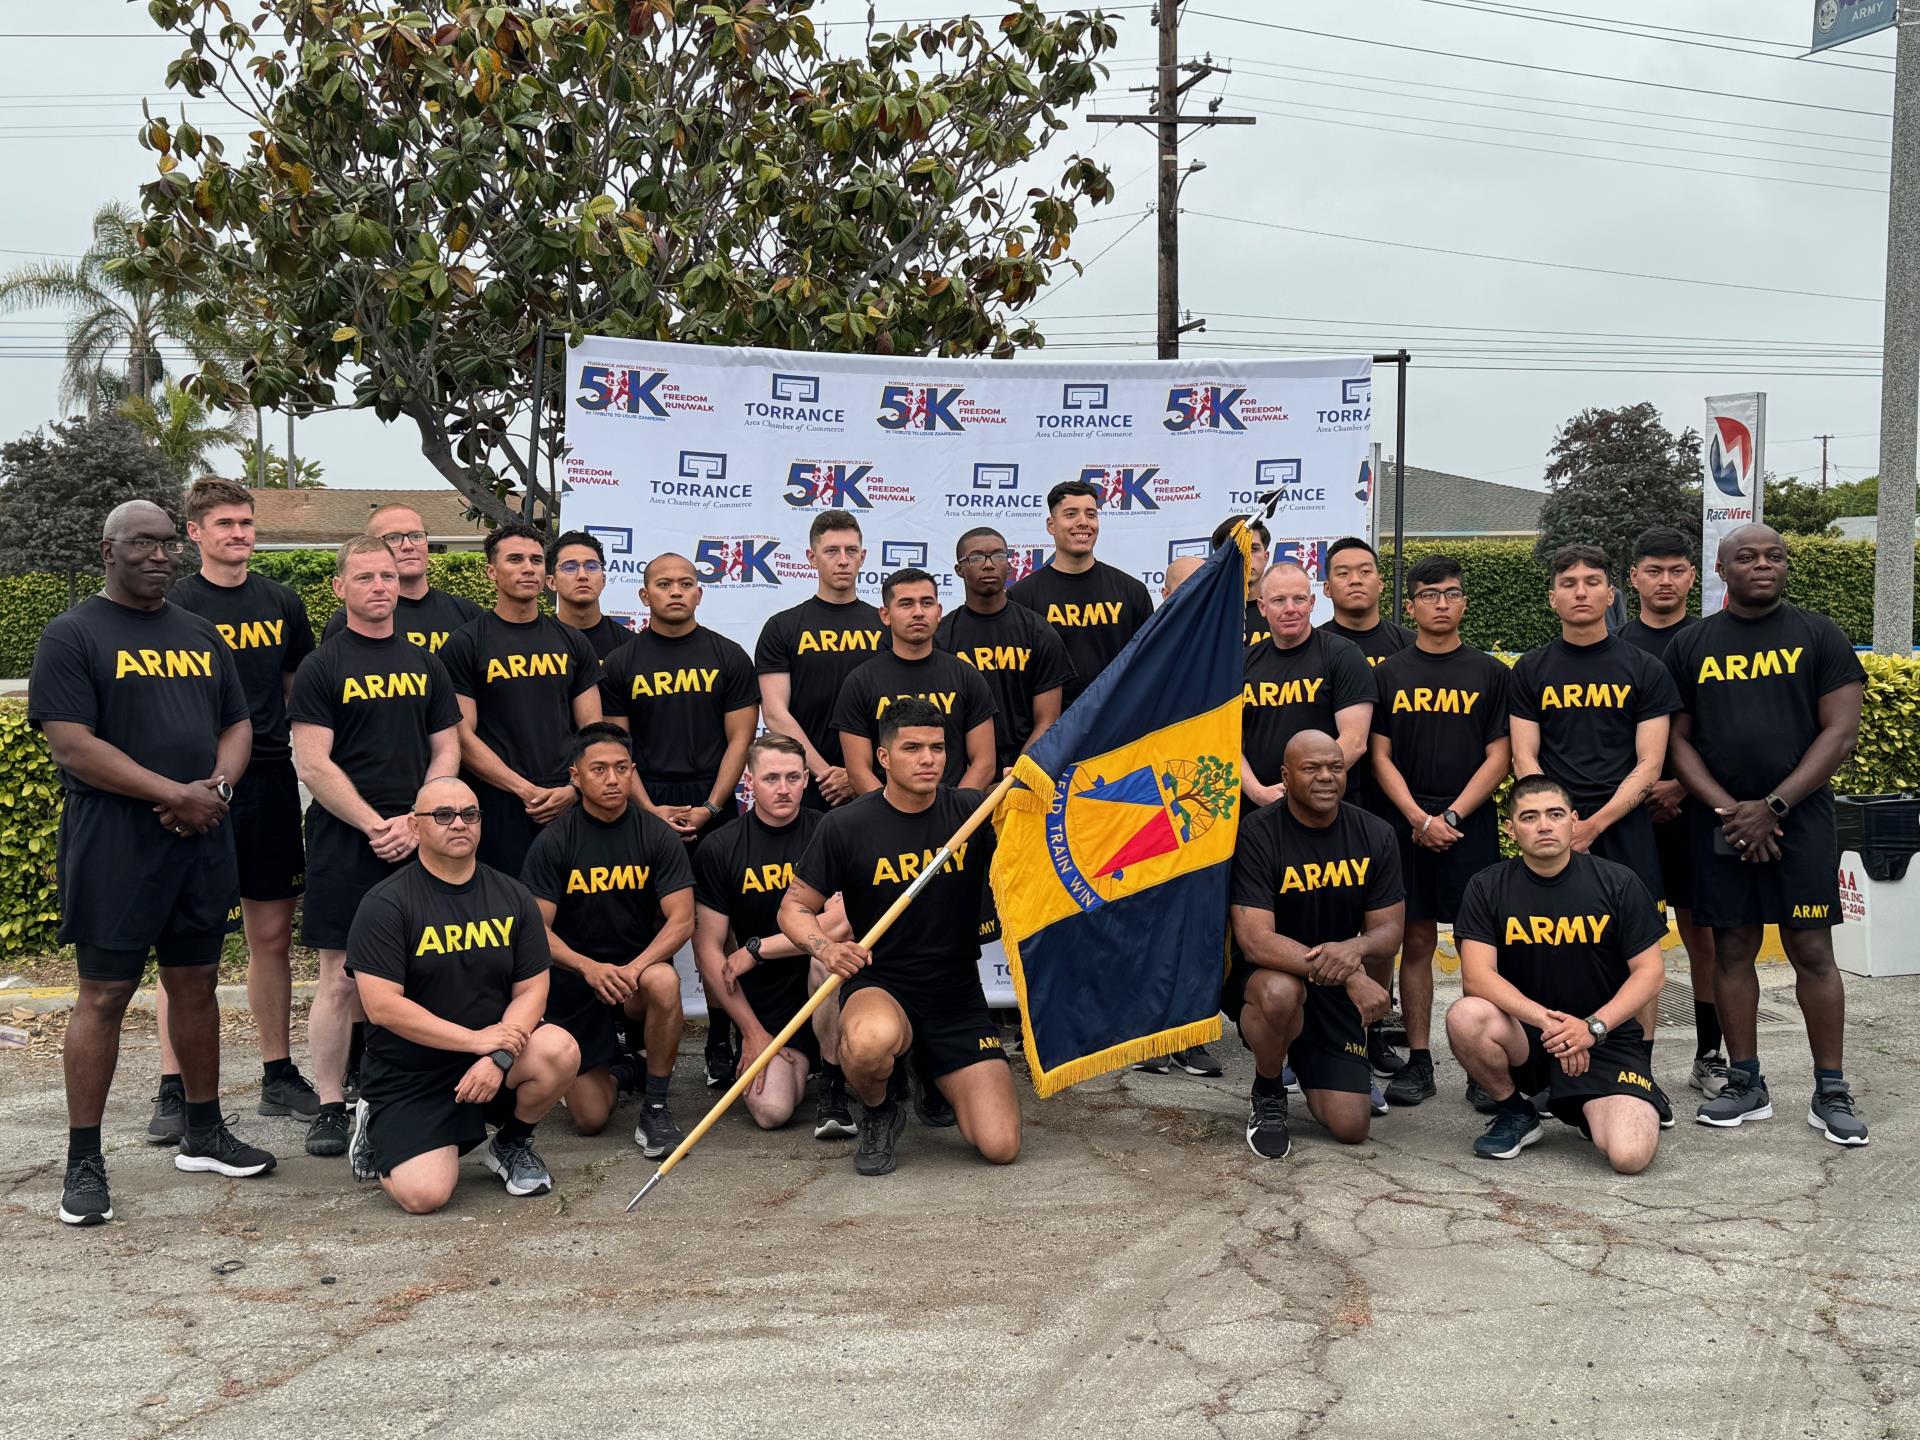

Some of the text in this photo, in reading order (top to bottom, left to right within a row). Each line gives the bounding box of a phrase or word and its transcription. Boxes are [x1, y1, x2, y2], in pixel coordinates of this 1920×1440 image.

[1851, 1, 1883, 22] ARMY
[664, 393, 707, 402] FREEDOM
[665, 402, 715, 412] RUN/WALK
[744, 403, 845, 422] TORRANCE
[1241, 406, 1282, 414] FREEDOM
[960, 416, 1007, 424] RUN/WALK
[1036, 415, 1133, 428] TORRANCE
[1243, 414, 1289, 422] RUN/WALK
[762, 420, 793, 430] Chamber
[796, 424, 805, 432] of
[806, 425, 845, 433] Commerce
[1052, 430, 1084, 438] Chamber
[1086, 430, 1094, 439] of
[1096, 430, 1133, 438] Commerce
[1316, 425, 1332, 433] Area
[1333, 424, 1363, 432] Chamber
[568, 468, 612, 476] FREEDOM
[569, 476, 620, 486] RUN/WALK
[650, 480, 752, 498] TORRANCE
[1154, 485, 1195, 493] FREEDOM
[667, 497, 700, 507] Chamber
[702, 500, 711, 509] of
[713, 501, 752, 509] Commerce
[869, 494, 916, 502] RUN/WALK
[945, 494, 1043, 508] TORRANCE
[1156, 493, 1201, 502] RUN/WALK
[1229, 488, 1325, 504] TORANCE
[995, 510, 1003, 519] of
[1005, 510, 1042, 518] Commerce
[1279, 505, 1287, 513] of
[1706, 507, 1751, 522] RaceWire
[609, 576, 618, 584] of
[777, 570, 819, 579] RUN/WAL
[1047, 602, 1123, 627] ARMY
[216, 619, 284, 649] RMY
[798, 629, 882, 655] ARMY
[116, 649, 212, 679] ARMY
[487, 653, 569, 684] ARMY
[1697, 648, 1803, 684] ARMY
[342, 673, 427, 704] ARMY
[631, 668, 719, 700] ARMY
[1242, 678, 1324, 708] ARMY
[1392, 687, 1480, 715] ARMY
[1541, 683, 1631, 710] ARMY
[875, 691, 957, 720] AY
[1050, 824, 1073, 874] TRAIN
[1069, 875, 1097, 908] WIN
[566, 865, 650, 894] ARMY
[741, 863, 796, 895] ARM
[1280, 858, 1371, 894] ARMY
[1840, 889, 1865, 904] SH, INC.
[226, 905, 241, 922] AR
[1657, 899, 1667, 913] MY
[1792, 904, 1830, 919] ARMY
[979, 918, 995, 936] MY
[1505, 914, 1611, 946] ARMY
[416, 917, 514, 956] ARMY
[978, 1036, 1001, 1051] ARM
[1344, 1042, 1368, 1058] ARM
[1617, 1070, 1652, 1092] ARMY
